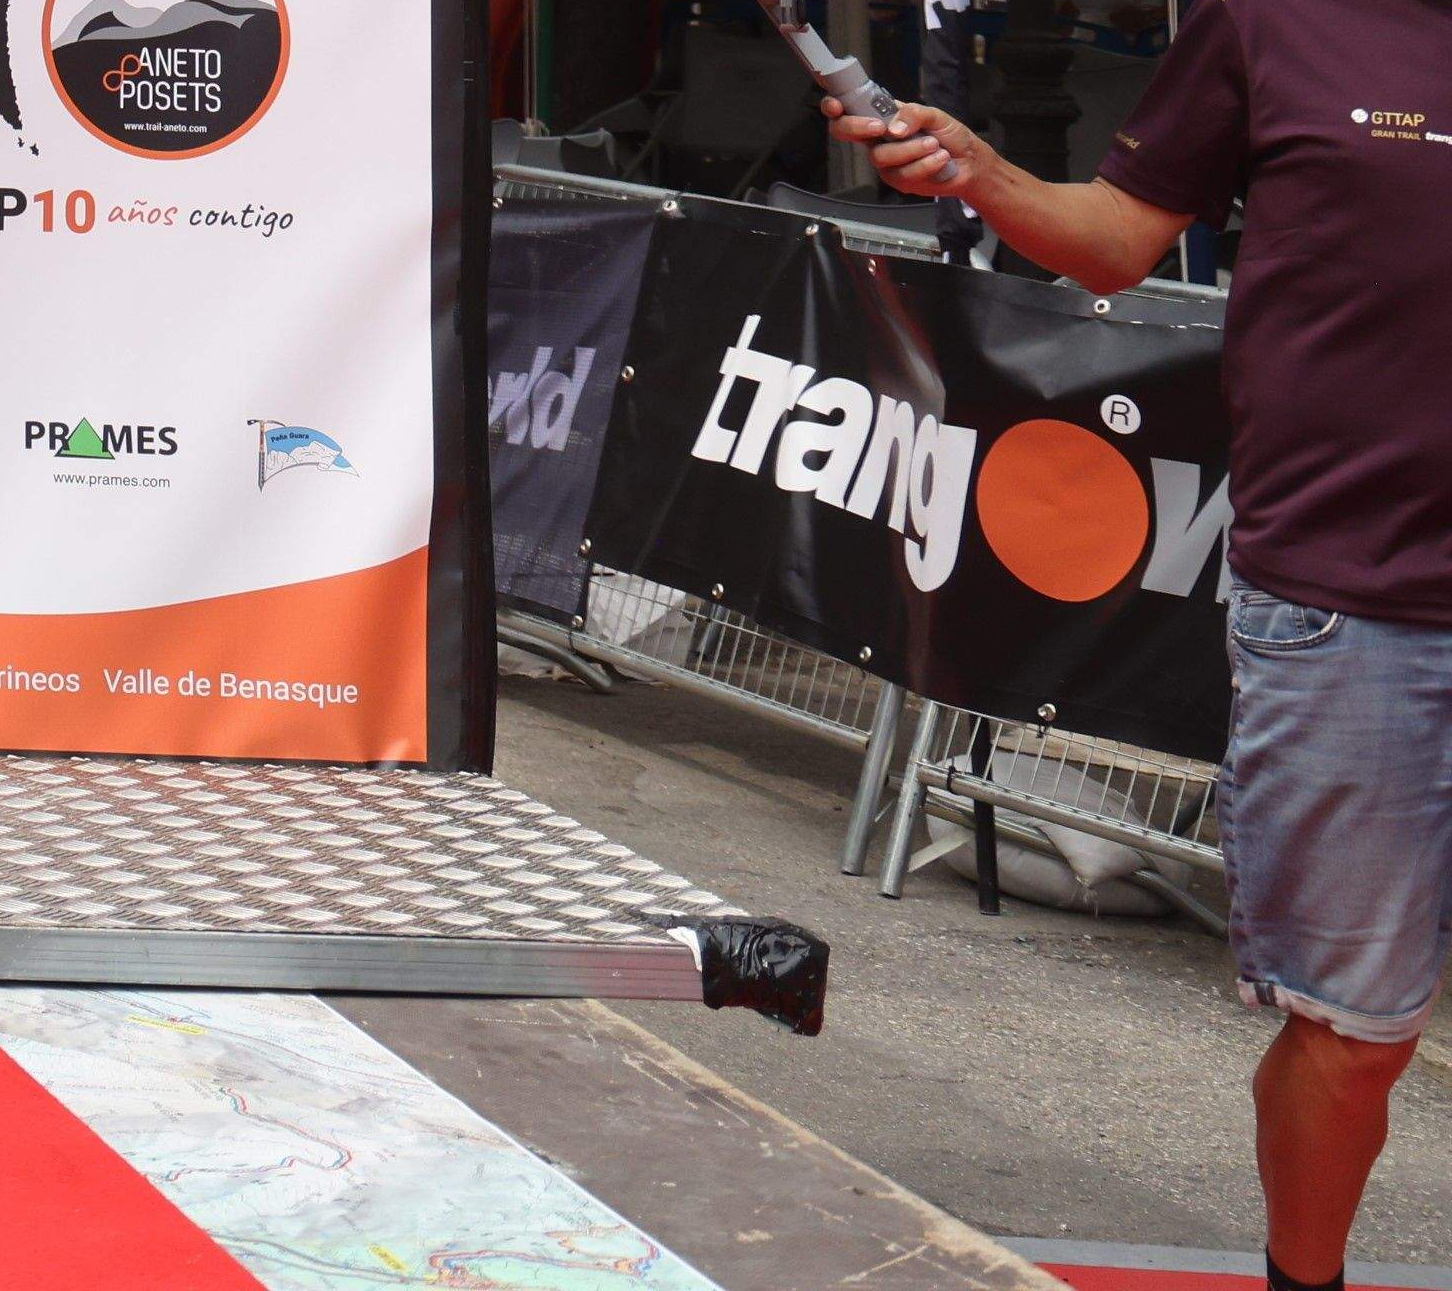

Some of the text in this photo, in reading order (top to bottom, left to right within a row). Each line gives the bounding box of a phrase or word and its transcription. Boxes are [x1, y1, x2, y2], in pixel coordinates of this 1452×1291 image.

[138, 47, 221, 79] ANETO
[119, 81, 222, 113] POSETS
[124, 122, 208, 134] www.trail-aneto.com
[1371, 111, 1425, 127] GTTAP
[1371, 129, 1395, 139] GRAN
[1398, 131, 1421, 140] TRAIL
[107, 199, 179, 228] años
[188, 201, 294, 238] contigo
[53, 473, 170, 487] www.prames.com
[103, 668, 170, 696] Valle
[178, 670, 211, 697] de
[220, 673, 358, 706] Benasque
